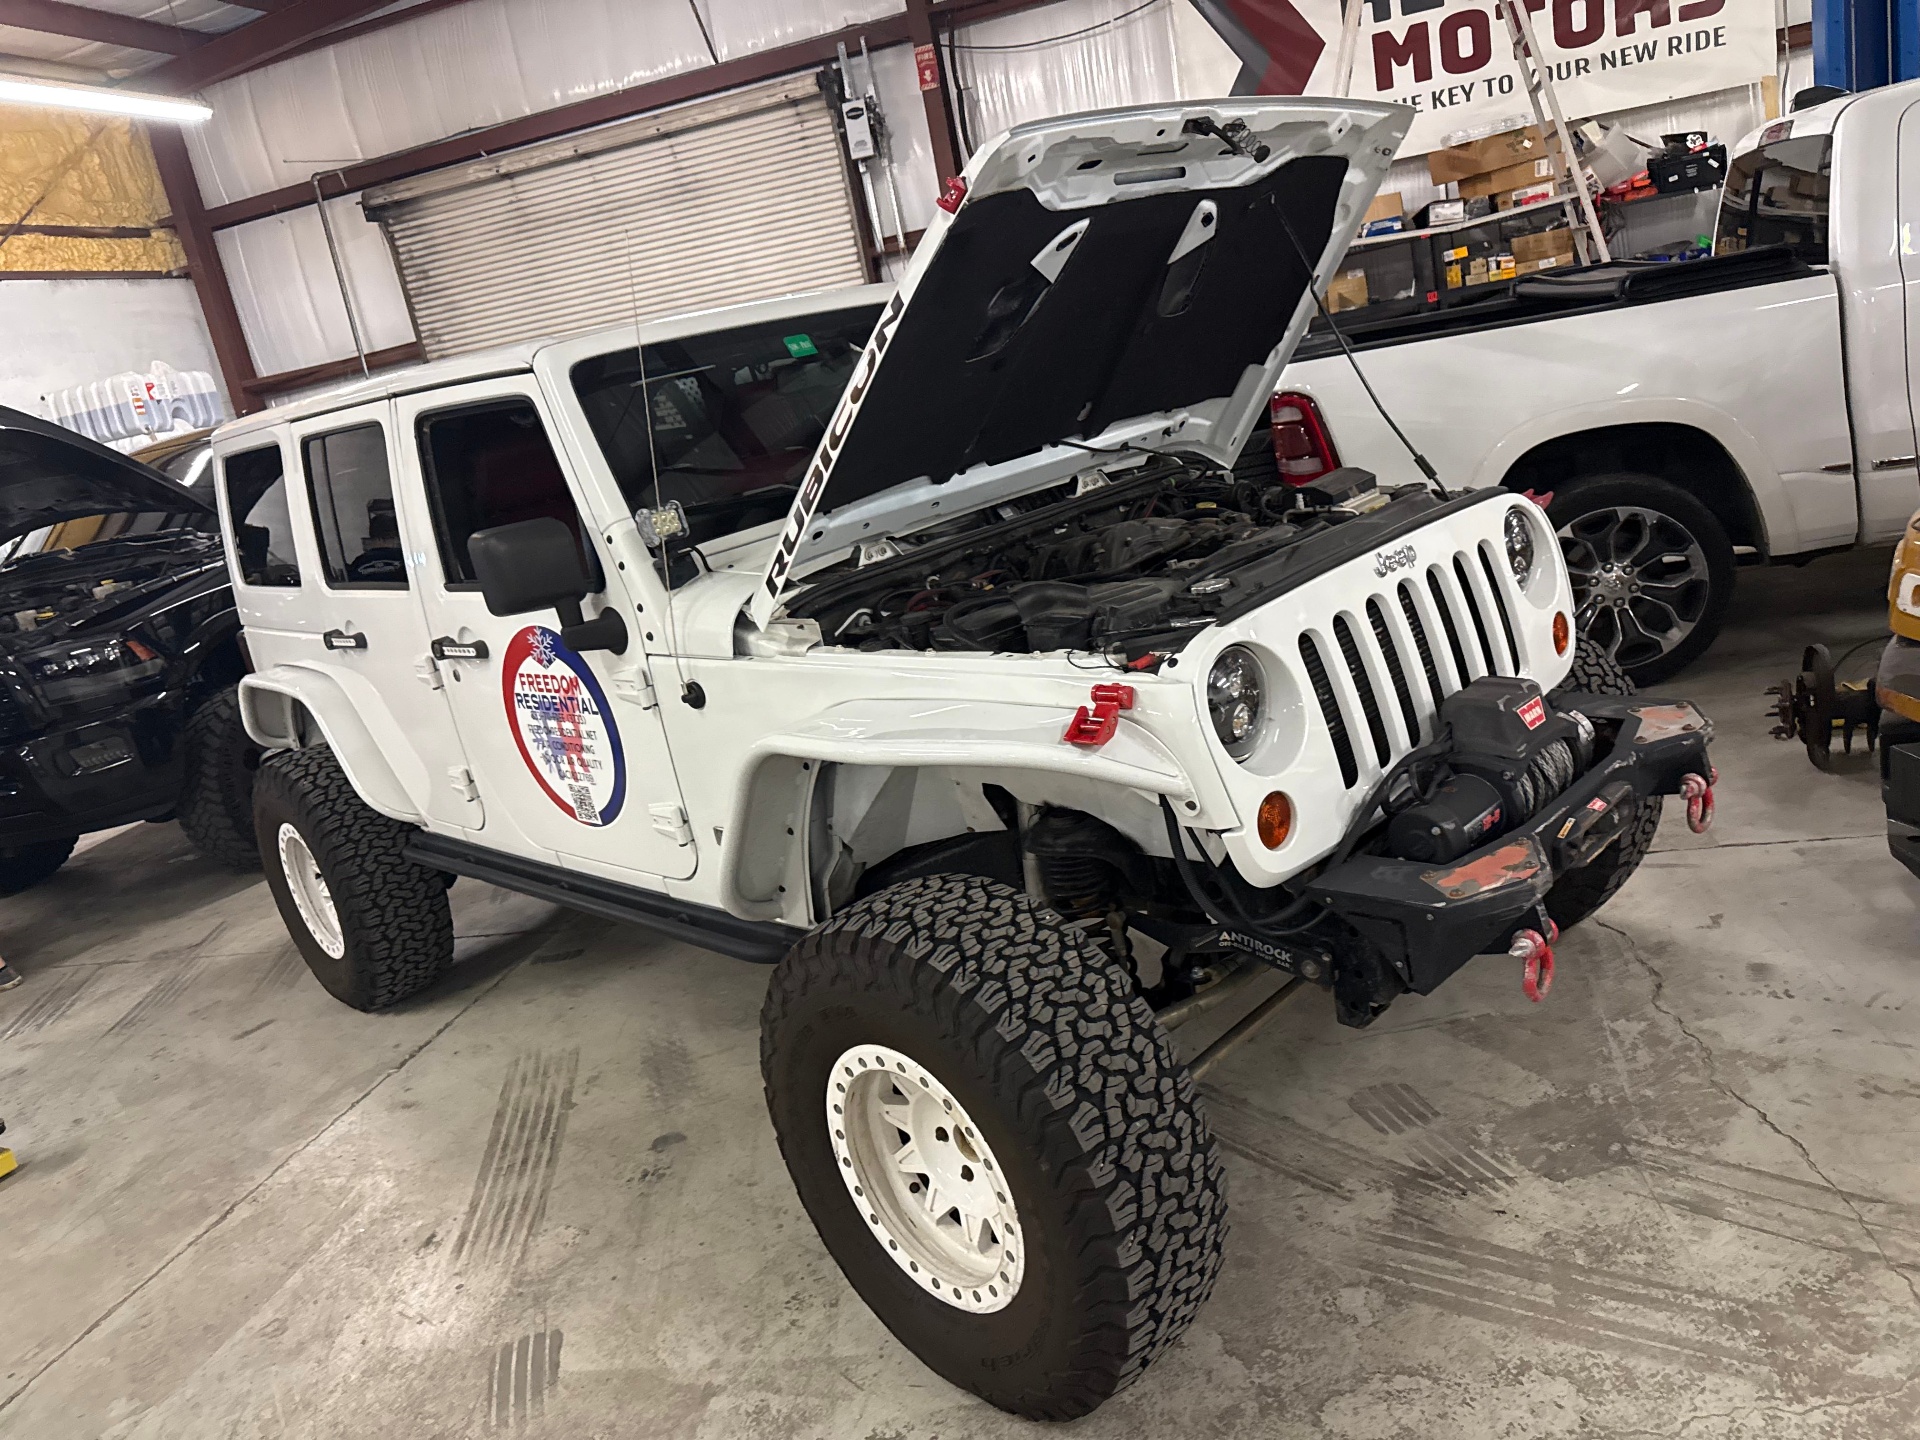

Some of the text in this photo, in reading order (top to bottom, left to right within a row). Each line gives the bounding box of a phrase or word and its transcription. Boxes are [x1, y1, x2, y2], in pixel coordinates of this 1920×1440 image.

[1431, 82, 1475, 110] KEY
[1486, 74, 1514, 99] TO
[1600, 39, 1658, 71] NEW
[1667, 25, 1727, 57] RIDE
[765, 289, 905, 600] RUBICON
[1373, 544, 1417, 578] Jeep
[518, 673, 582, 695] FREEDOM
[514, 693, 599, 715] RESIDENTIAL
[1219, 931, 1292, 962] ANTIROCK
